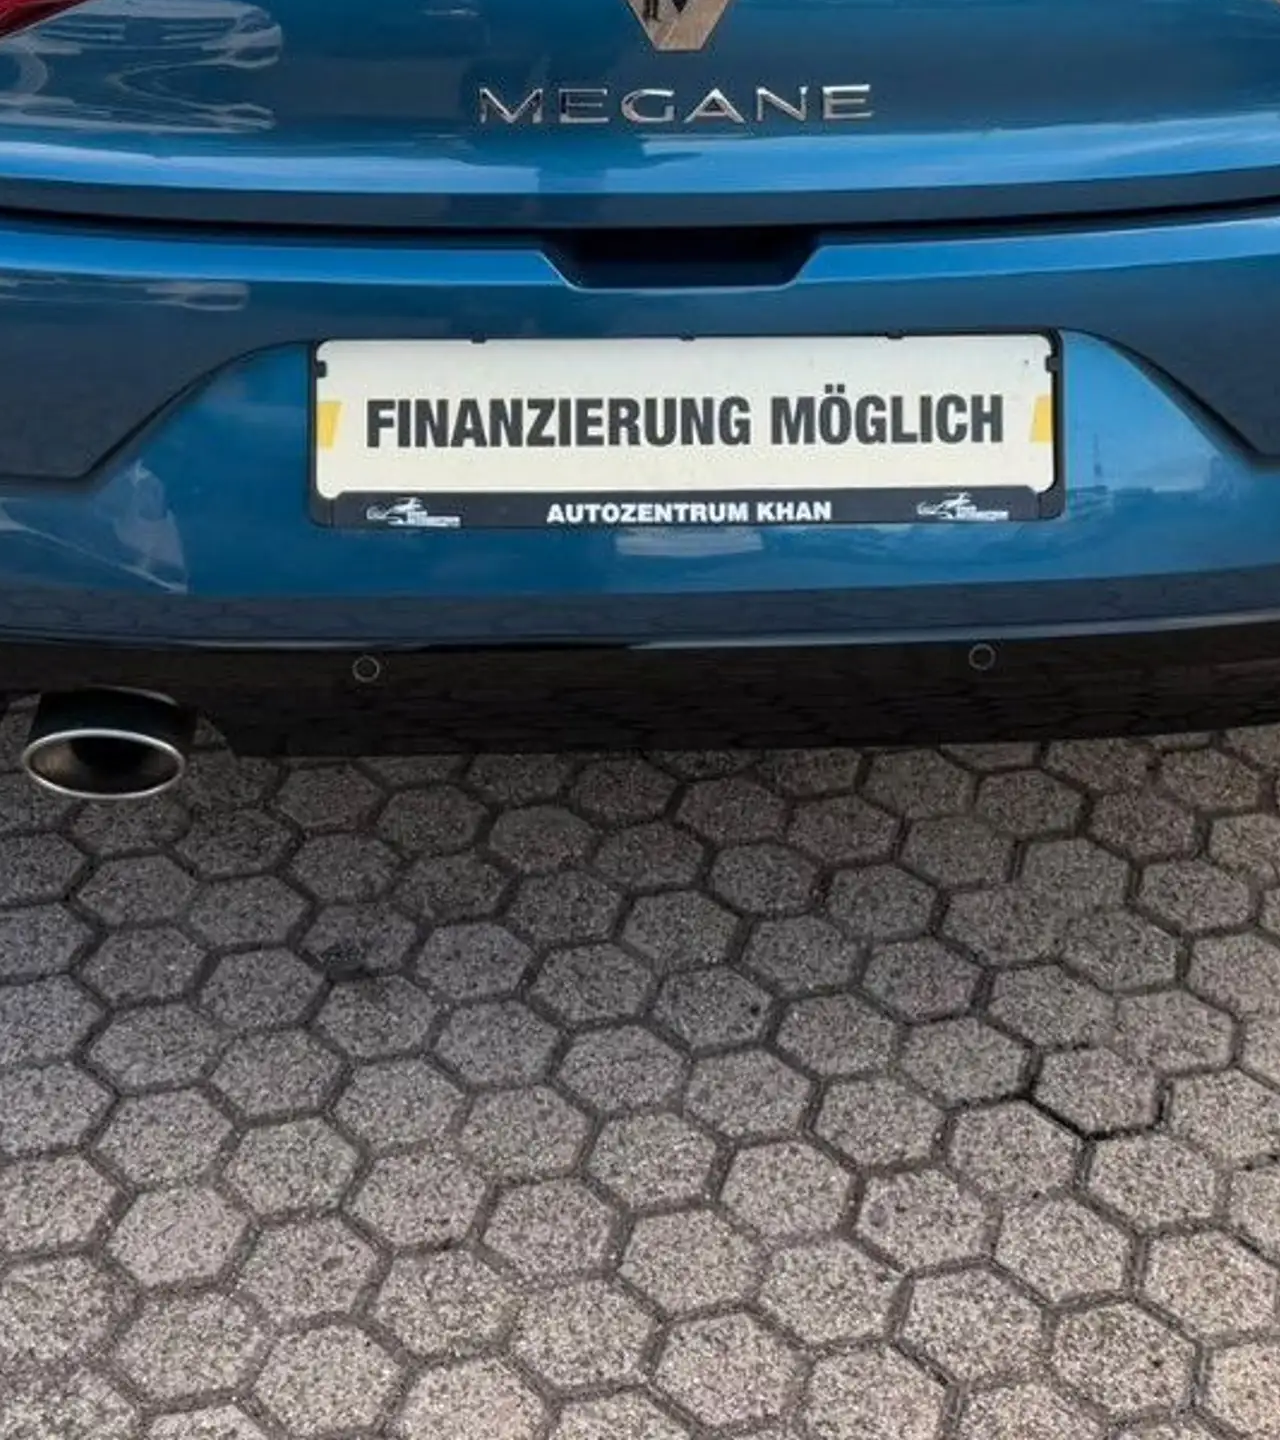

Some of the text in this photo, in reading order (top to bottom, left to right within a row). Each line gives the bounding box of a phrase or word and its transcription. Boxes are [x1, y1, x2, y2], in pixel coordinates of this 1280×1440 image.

[478, 83, 874, 125] MEGANE
[366, 384, 1005, 448] FINANZIERUNG MÖGLICH
[546, 501, 832, 524] AUTOZENTRUM KHAN
